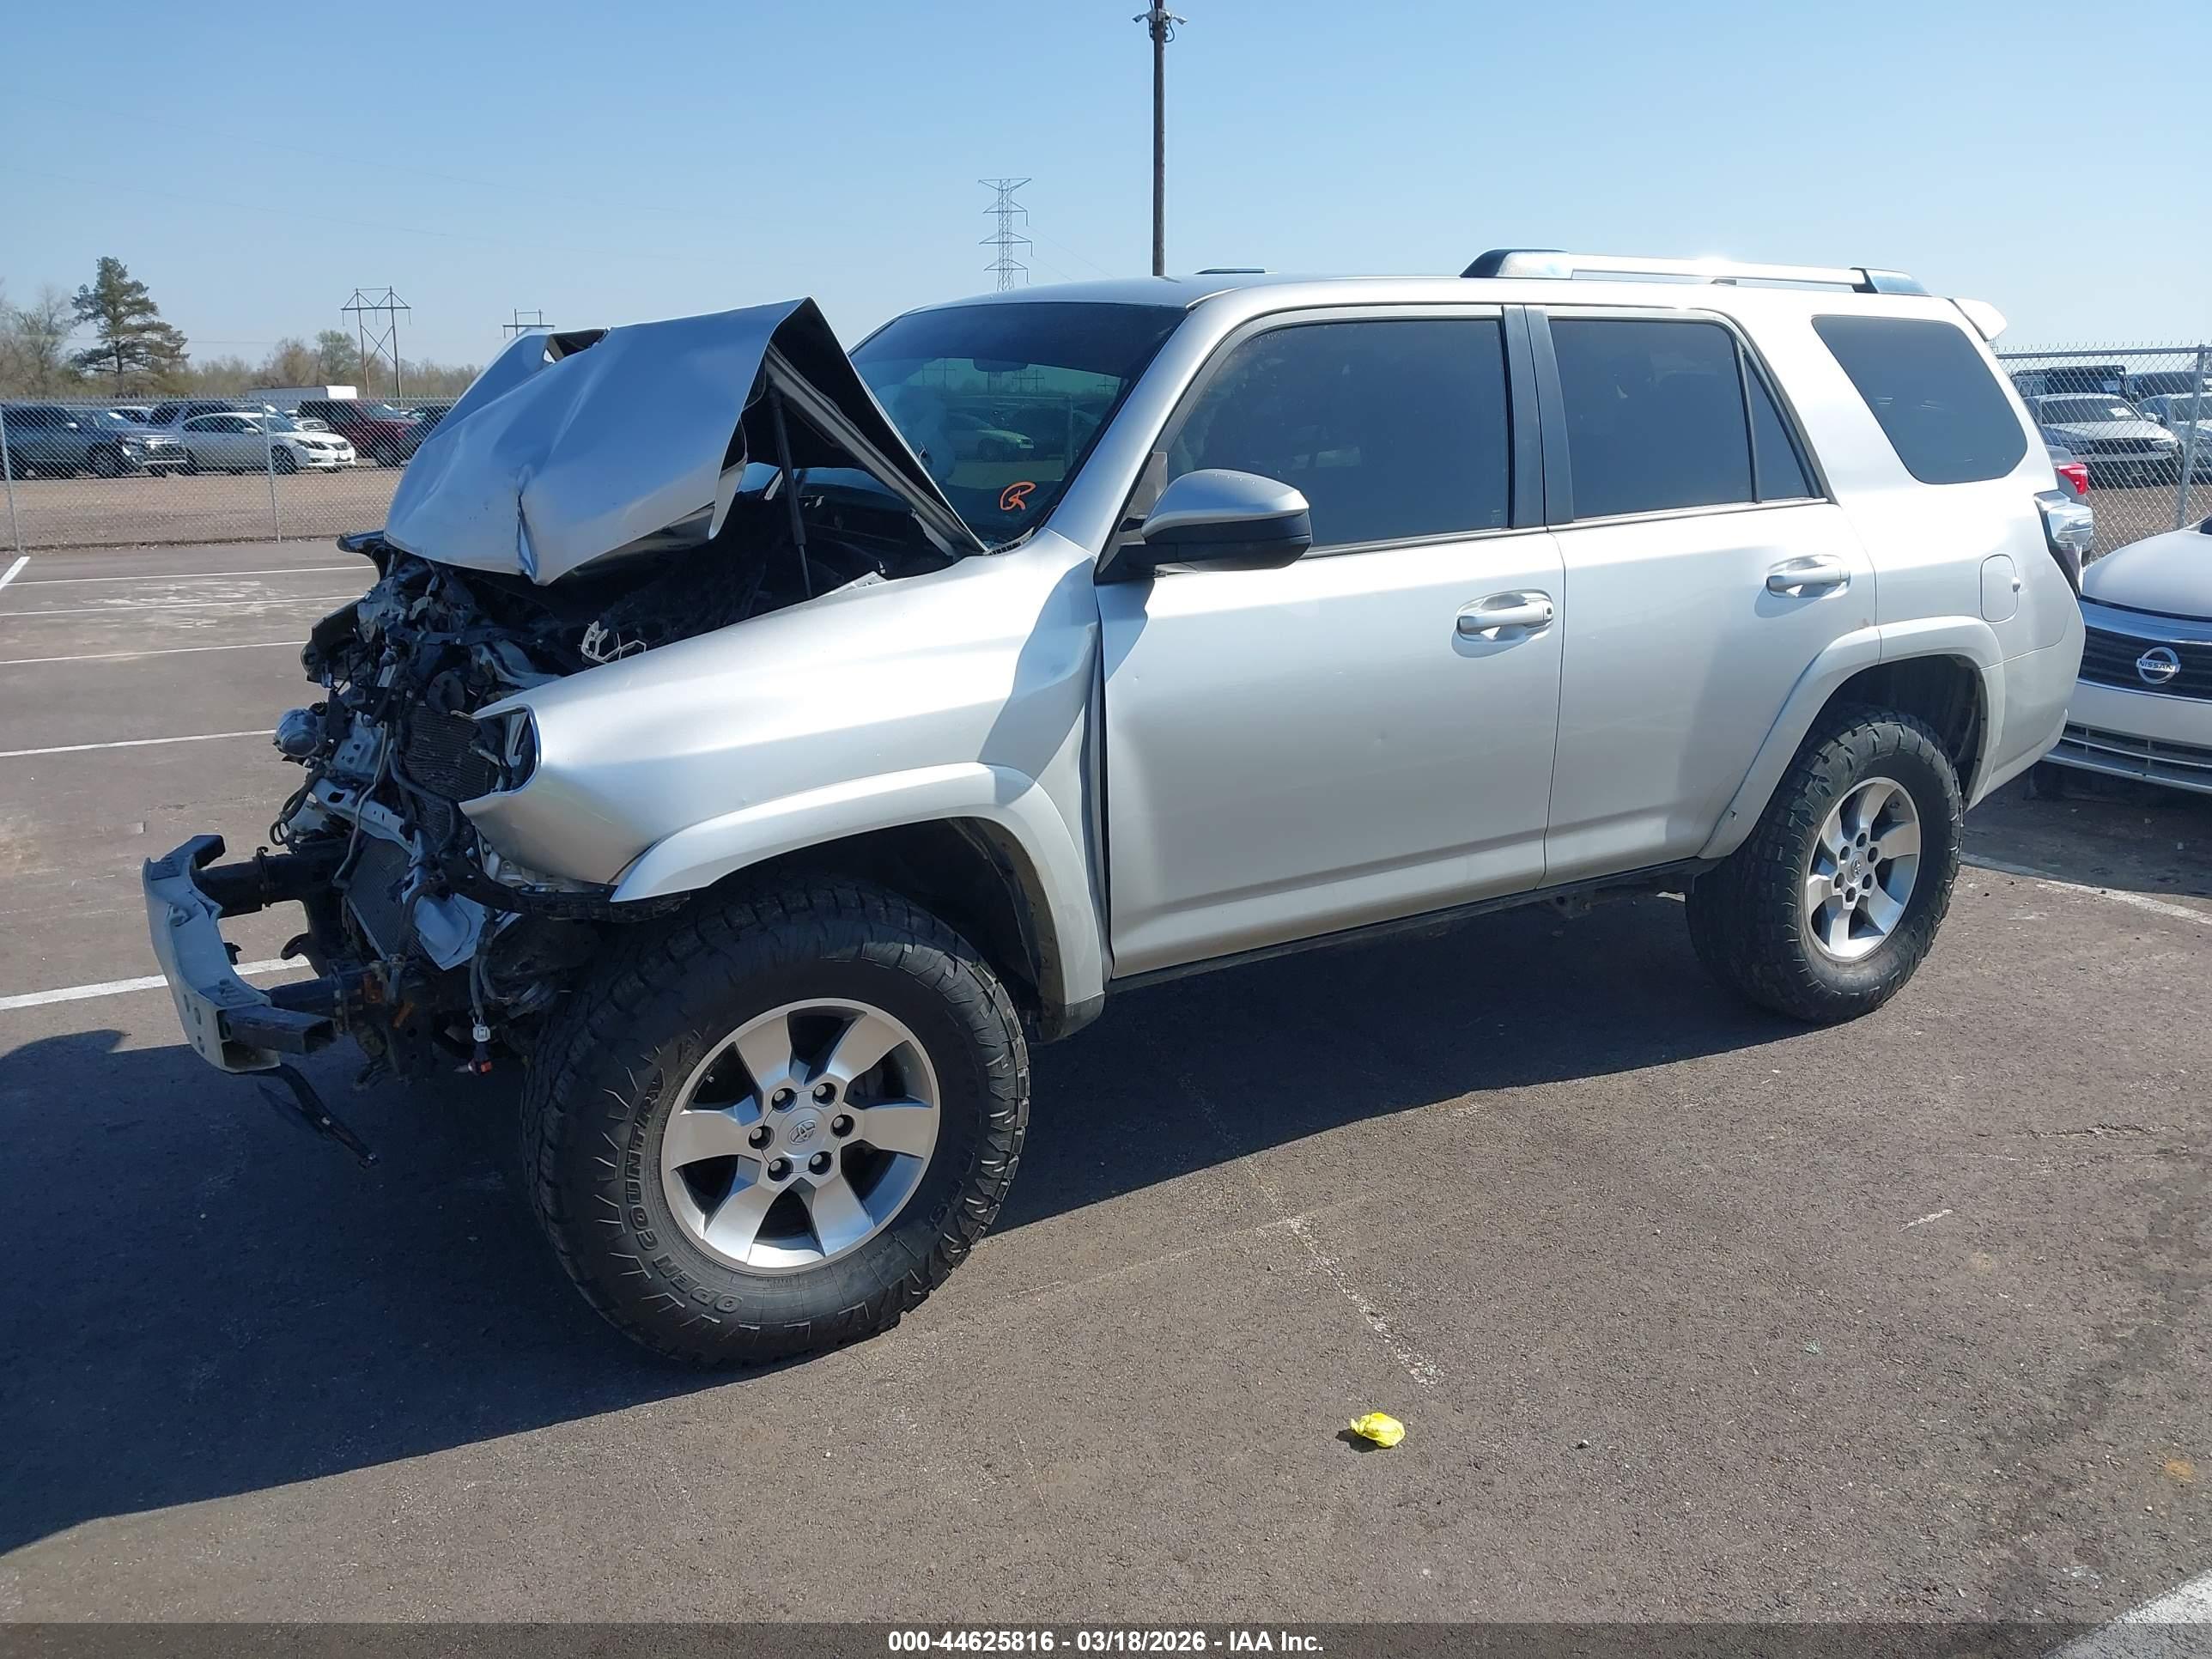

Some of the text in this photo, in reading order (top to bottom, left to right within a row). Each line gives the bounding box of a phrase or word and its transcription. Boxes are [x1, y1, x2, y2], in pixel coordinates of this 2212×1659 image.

[2139, 660, 2174, 670] NISSAN
[624, 1067, 744, 1314] OPEN COUNTRY
